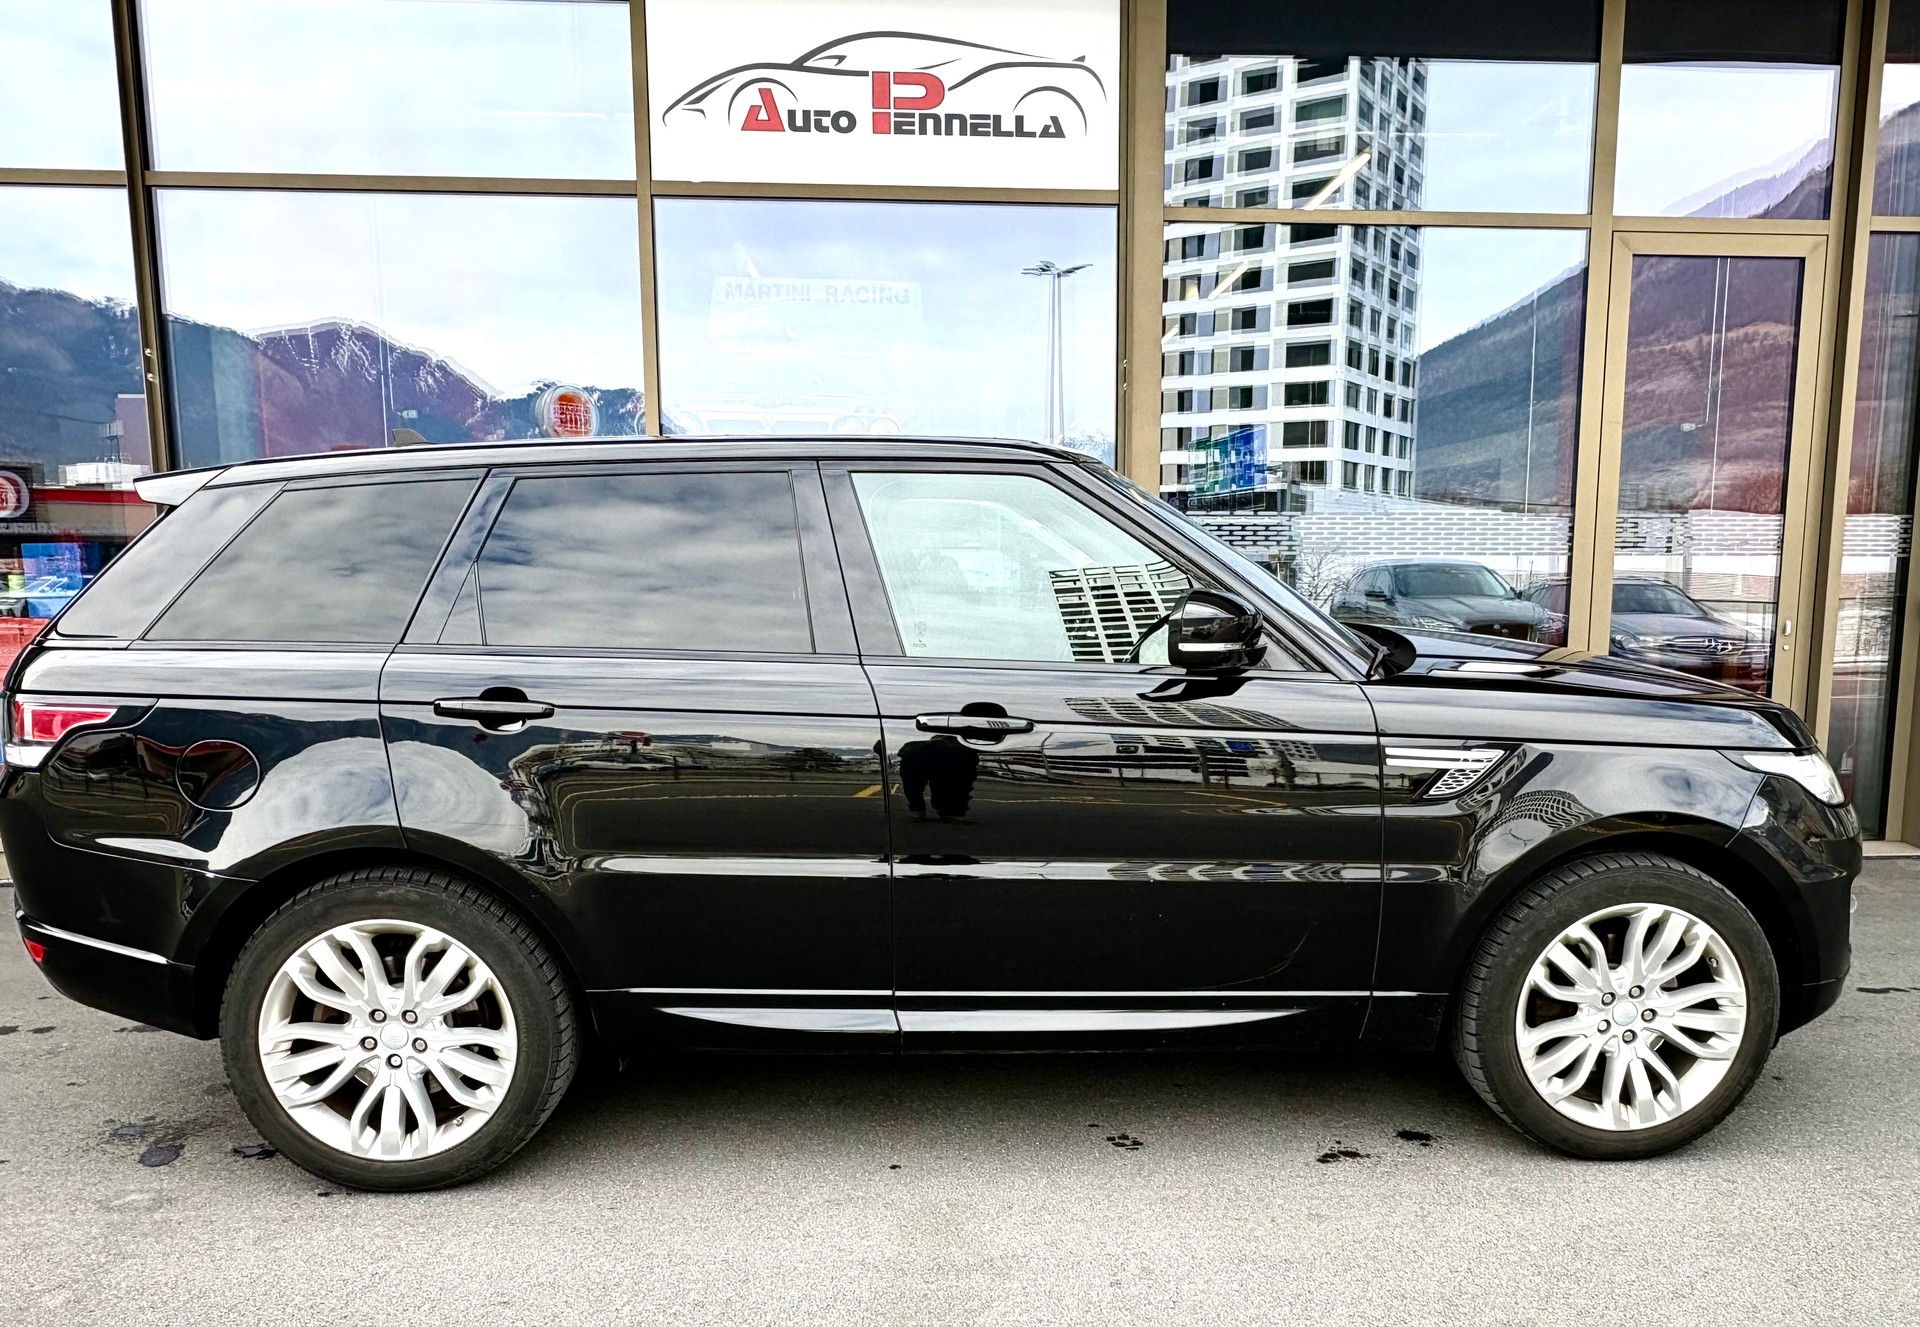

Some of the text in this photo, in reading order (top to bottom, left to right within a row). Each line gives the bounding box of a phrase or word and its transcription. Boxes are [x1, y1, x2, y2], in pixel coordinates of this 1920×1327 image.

[871, 71, 1066, 138] PENNELLA
[725, 282, 910, 305] MARTINI RACING
